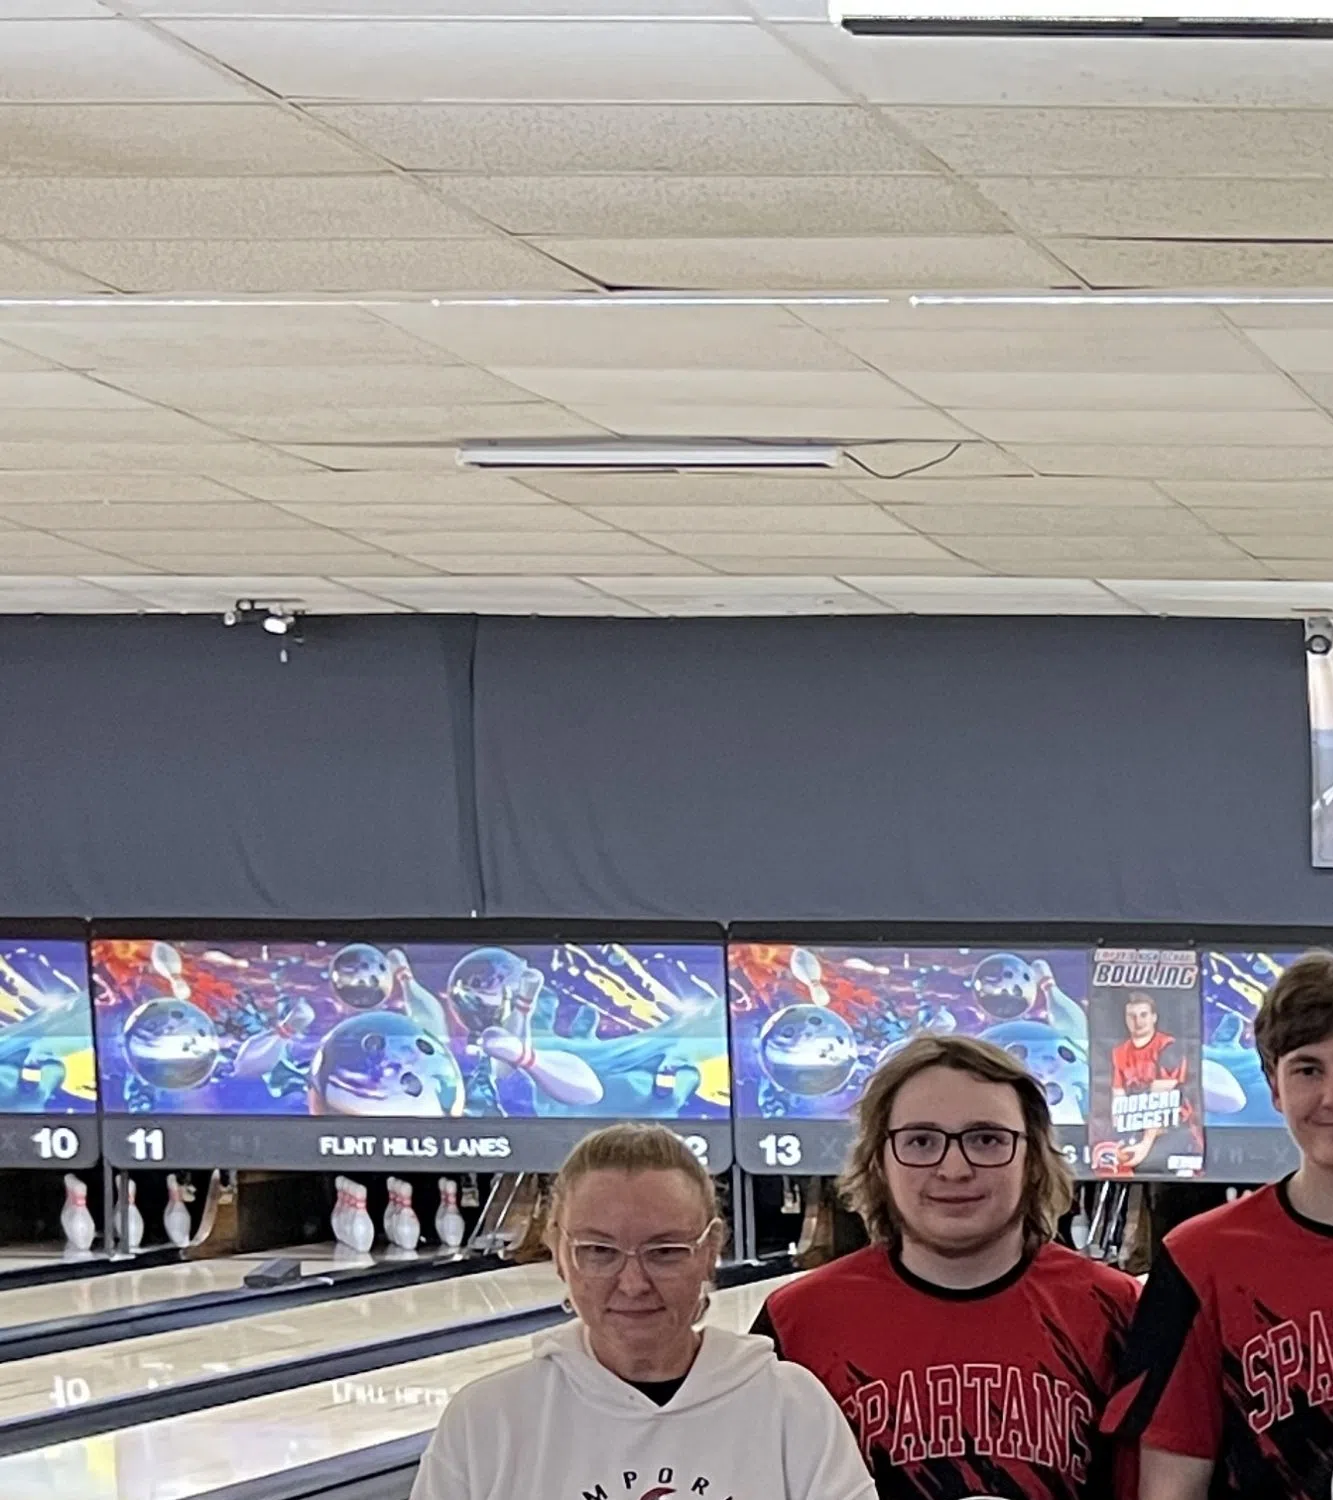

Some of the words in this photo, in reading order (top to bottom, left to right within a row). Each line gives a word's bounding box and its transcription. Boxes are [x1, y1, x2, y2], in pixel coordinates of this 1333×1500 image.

[1093, 963, 1198, 988] BOWLING
[32, 1127, 79, 1159] 10
[127, 1128, 164, 1160] 11
[320, 1137, 377, 1156] FLINT
[383, 1137, 438, 1157] HILLS
[444, 1138, 511, 1157] LANES
[759, 1134, 802, 1167] 13
